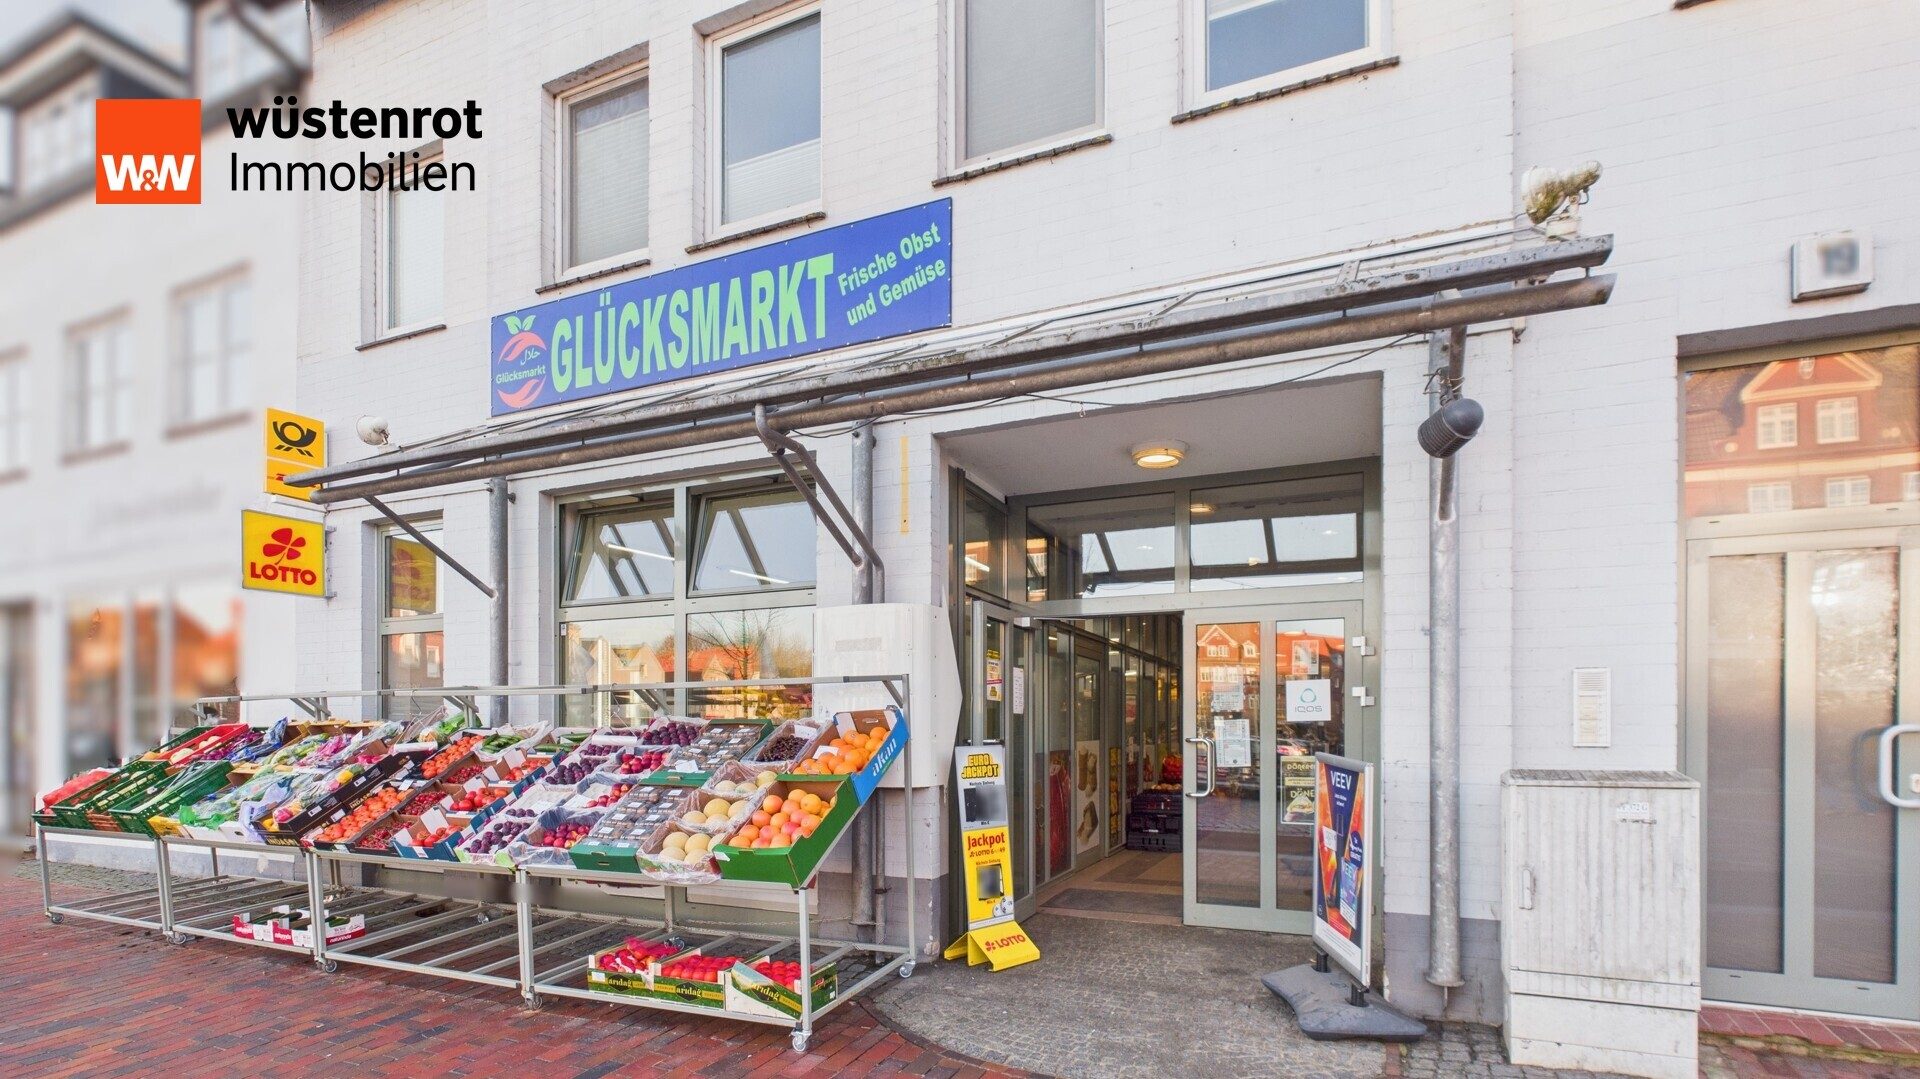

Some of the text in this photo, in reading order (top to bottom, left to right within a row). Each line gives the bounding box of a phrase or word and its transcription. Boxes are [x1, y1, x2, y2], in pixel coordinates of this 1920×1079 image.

[837, 221, 941, 297] Frische Obst
[846, 259, 946, 327] und Gemüse
[551, 252, 834, 394] GLÜCKSMARKT
[495, 364, 546, 385] Glücksmarkt
[249, 561, 317, 586] LOTTO
[967, 753, 991, 766] EURO
[961, 764, 999, 780] JACKPOT
[1330, 770, 1352, 791] VEEV
[1290, 787, 1316, 799] DÖNE
[967, 832, 1006, 851] Jackpot
[975, 849, 991, 857] LOTTO
[995, 934, 1026, 948] LOTTO
